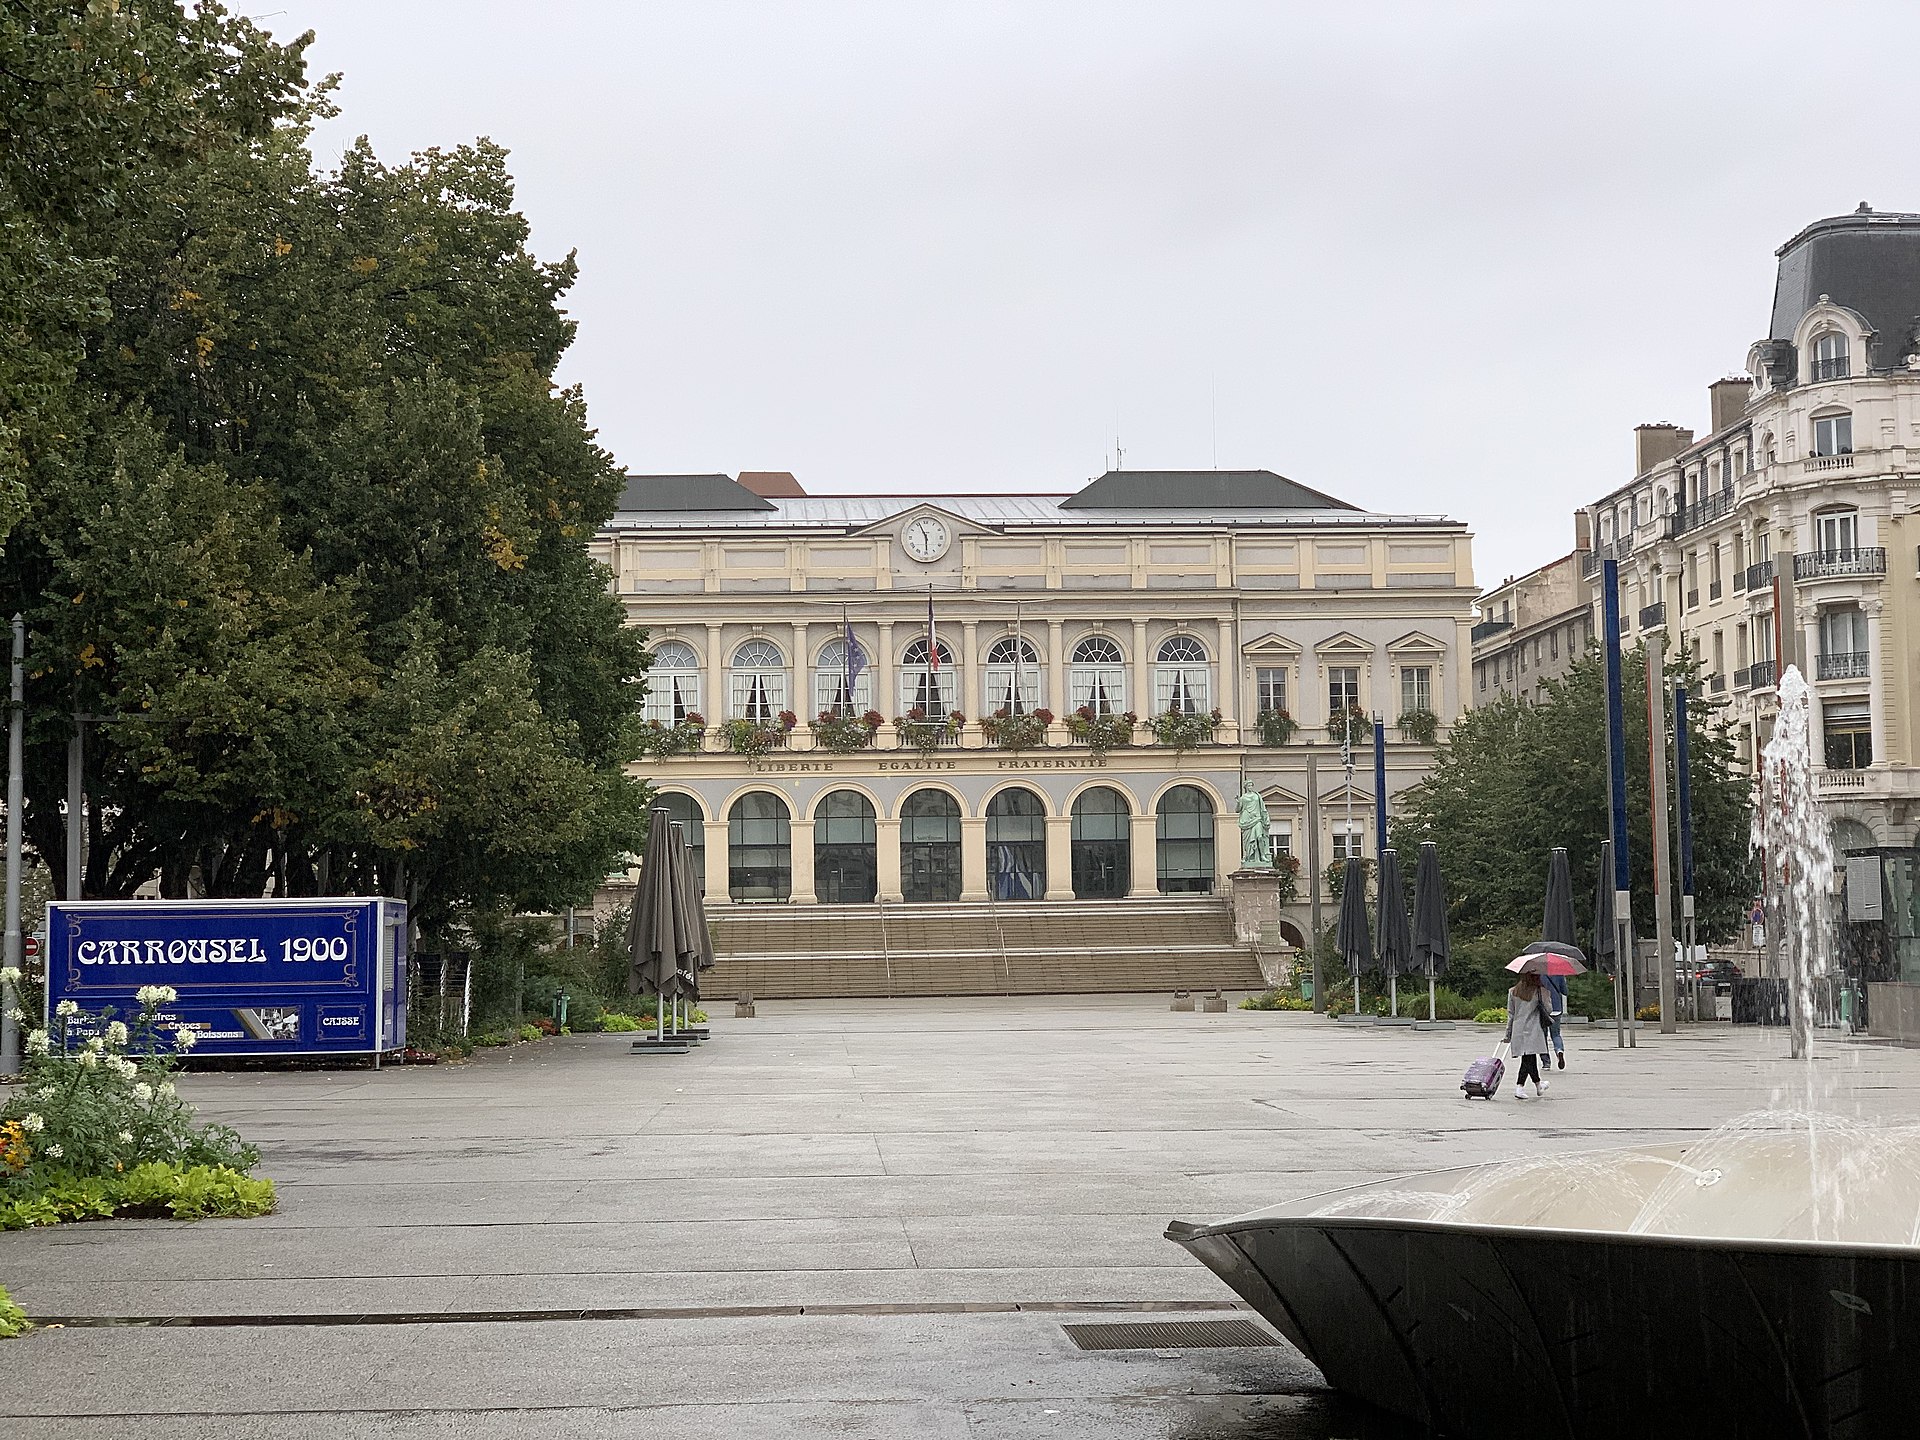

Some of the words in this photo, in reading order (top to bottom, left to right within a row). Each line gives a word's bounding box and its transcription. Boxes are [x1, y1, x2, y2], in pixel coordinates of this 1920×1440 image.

[756, 763, 834, 772] LIBERTE
[878, 761, 956, 770] EGALITE
[77, 938, 267, 964] CARROUSEL
[279, 937, 348, 962] 1900
[138, 1012, 177, 1021] Gufres
[322, 1016, 360, 1026] CAISSE
[168, 1021, 201, 1030] Crêpes
[196, 1030, 240, 1039] Boissons
